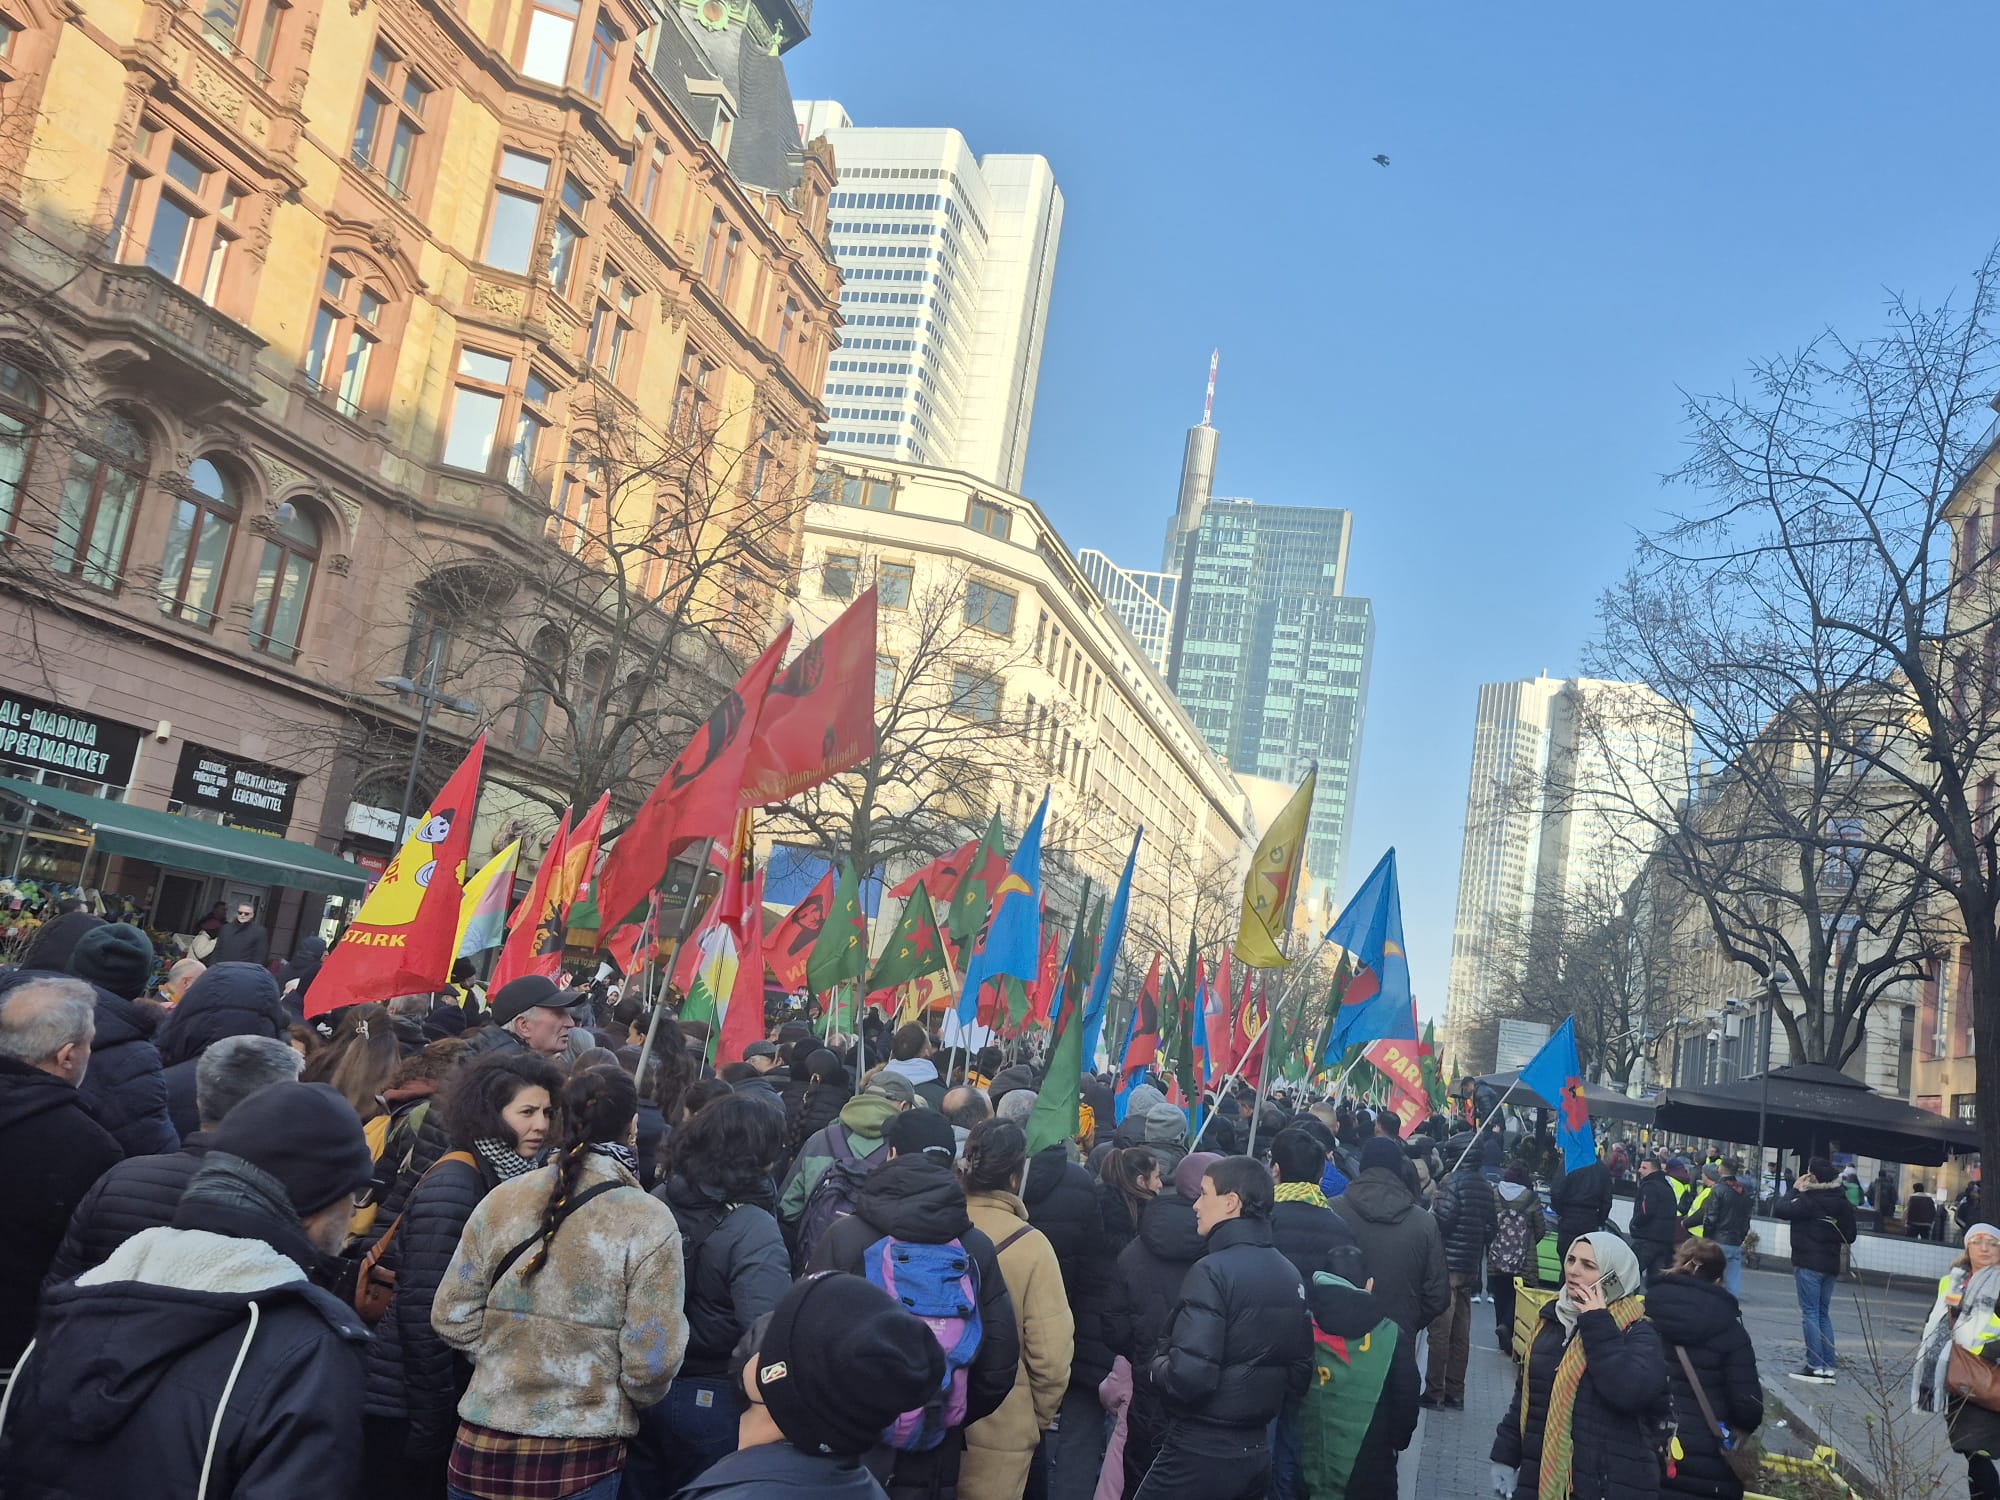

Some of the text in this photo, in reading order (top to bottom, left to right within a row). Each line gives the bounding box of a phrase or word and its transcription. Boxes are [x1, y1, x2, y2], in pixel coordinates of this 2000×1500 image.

[0, 700, 97, 746] AL-MADINA
[234, 770, 289, 796] ORIENTALISCHE
[231, 788, 282, 812] LEBENSMITTEL
[341, 929, 407, 947] STARK
